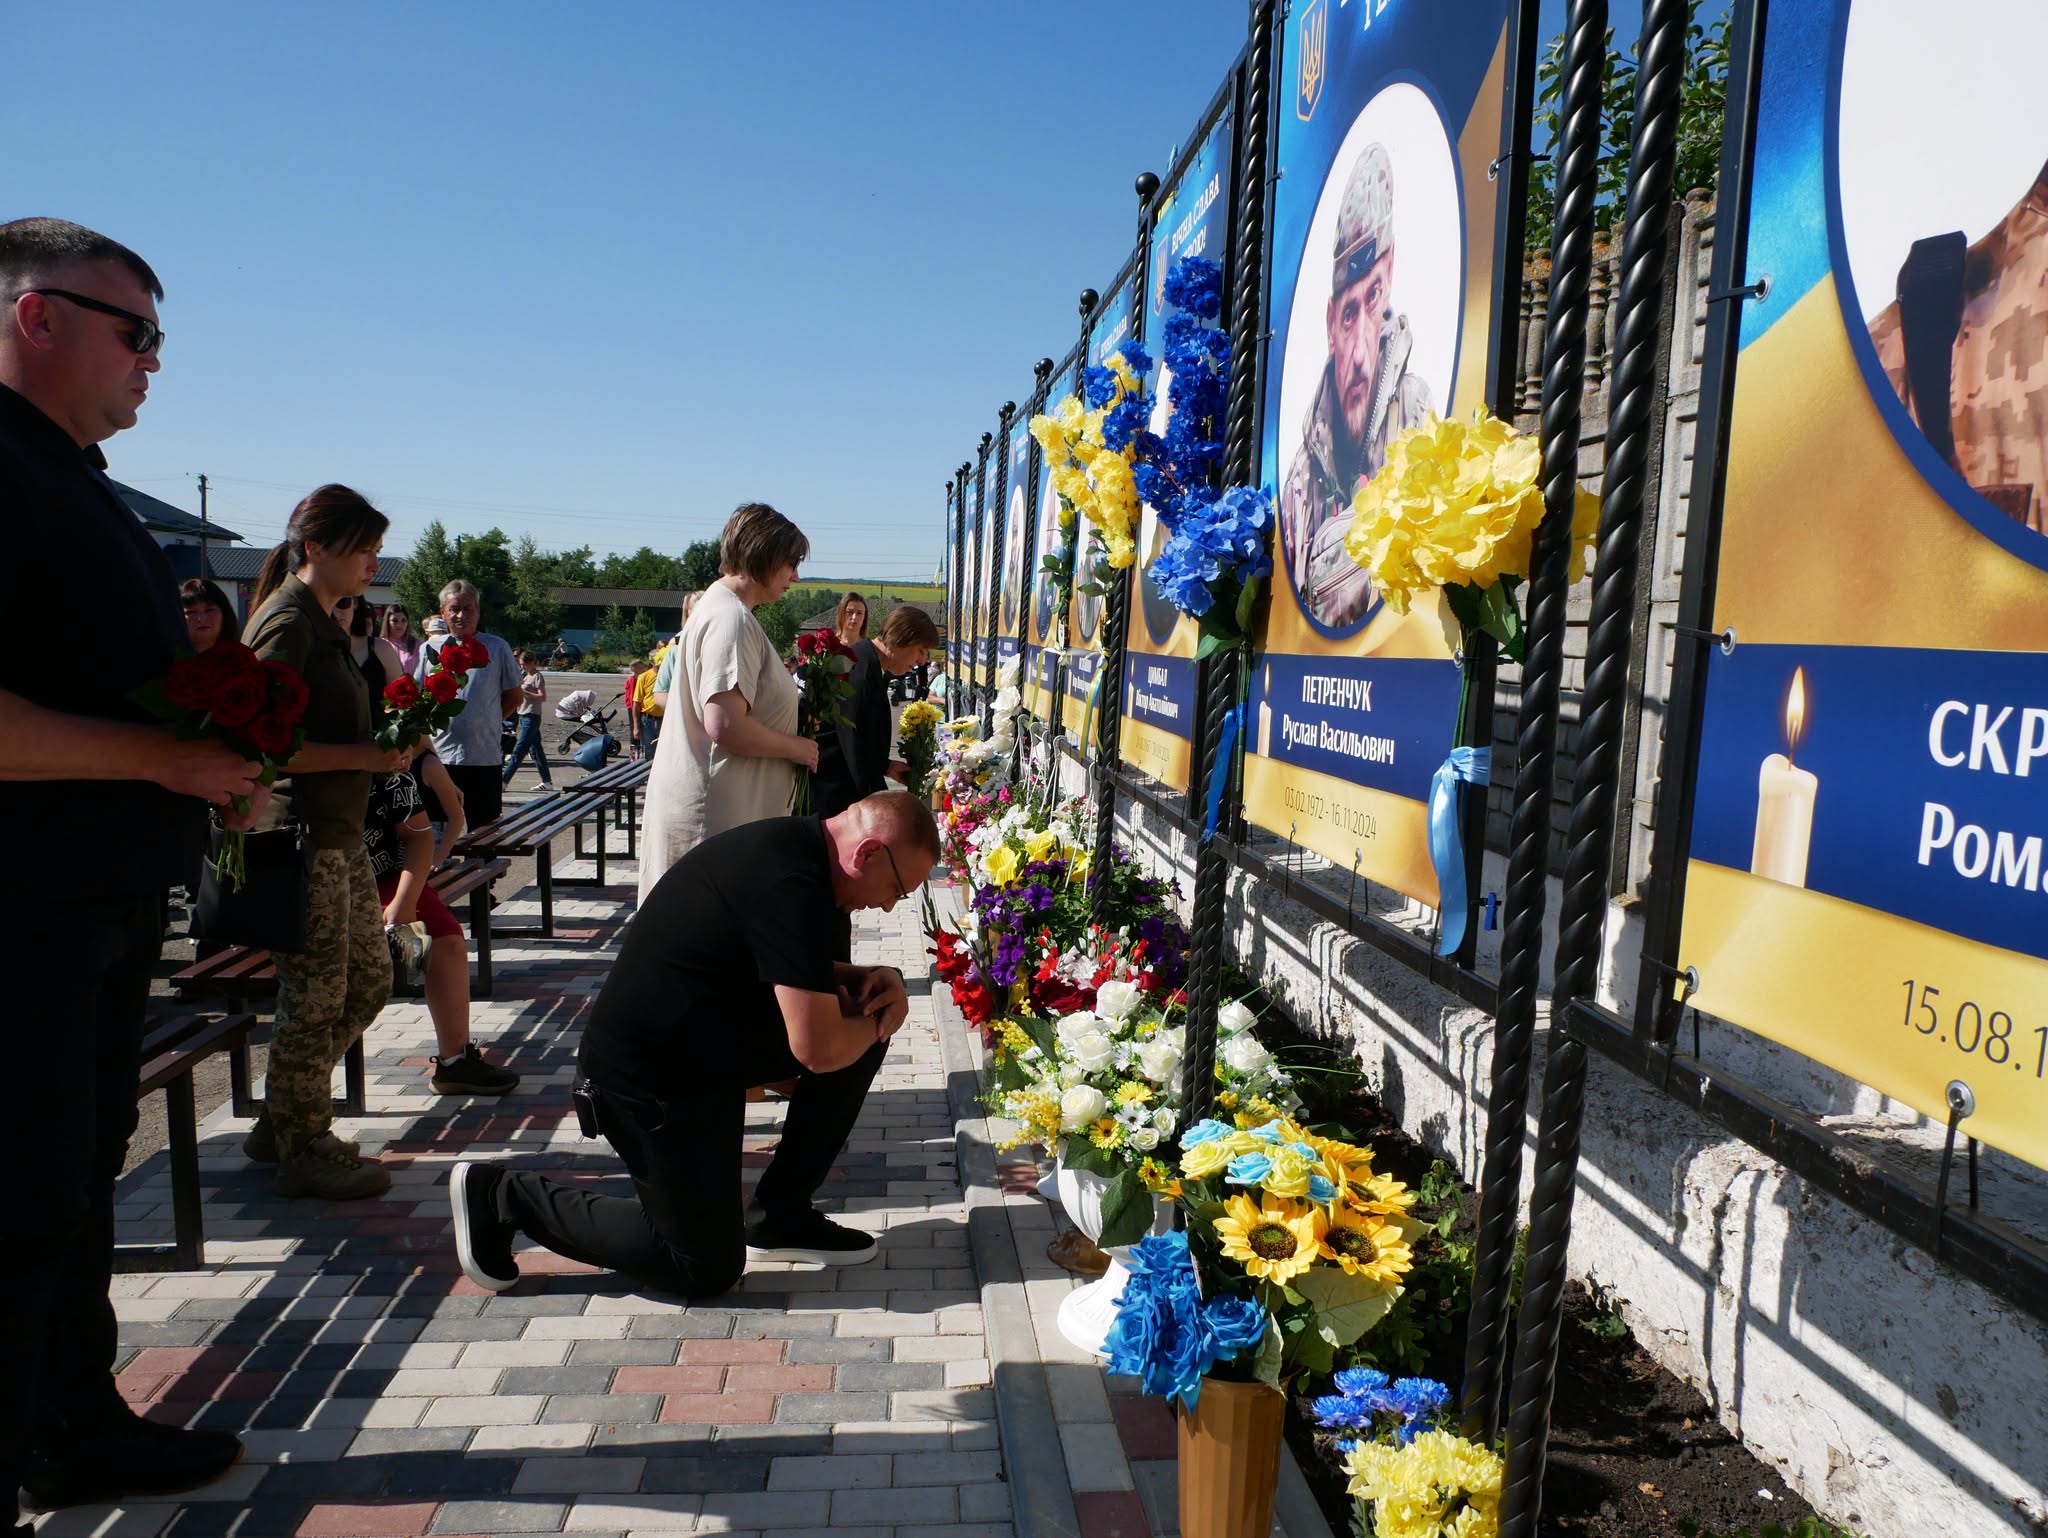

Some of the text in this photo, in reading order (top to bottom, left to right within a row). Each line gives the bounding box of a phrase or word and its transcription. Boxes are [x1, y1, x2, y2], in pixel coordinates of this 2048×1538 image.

[1193, 172, 1220, 225] СЛАВА
[1180, 224, 1207, 260] РОЮ!
[1147, 665, 1168, 688] ЦИМБАЛ
[1302, 675, 1373, 712] ПЕТРЕНЧУК
[1282, 713, 1396, 765] Руслан Васильович
[392, 786, 423, 809] AIR
[1284, 786, 1324, 820] 03.02.1972
[1331, 802, 1377, 841] 16.11.2024
[1917, 801, 2048, 893] Ром
